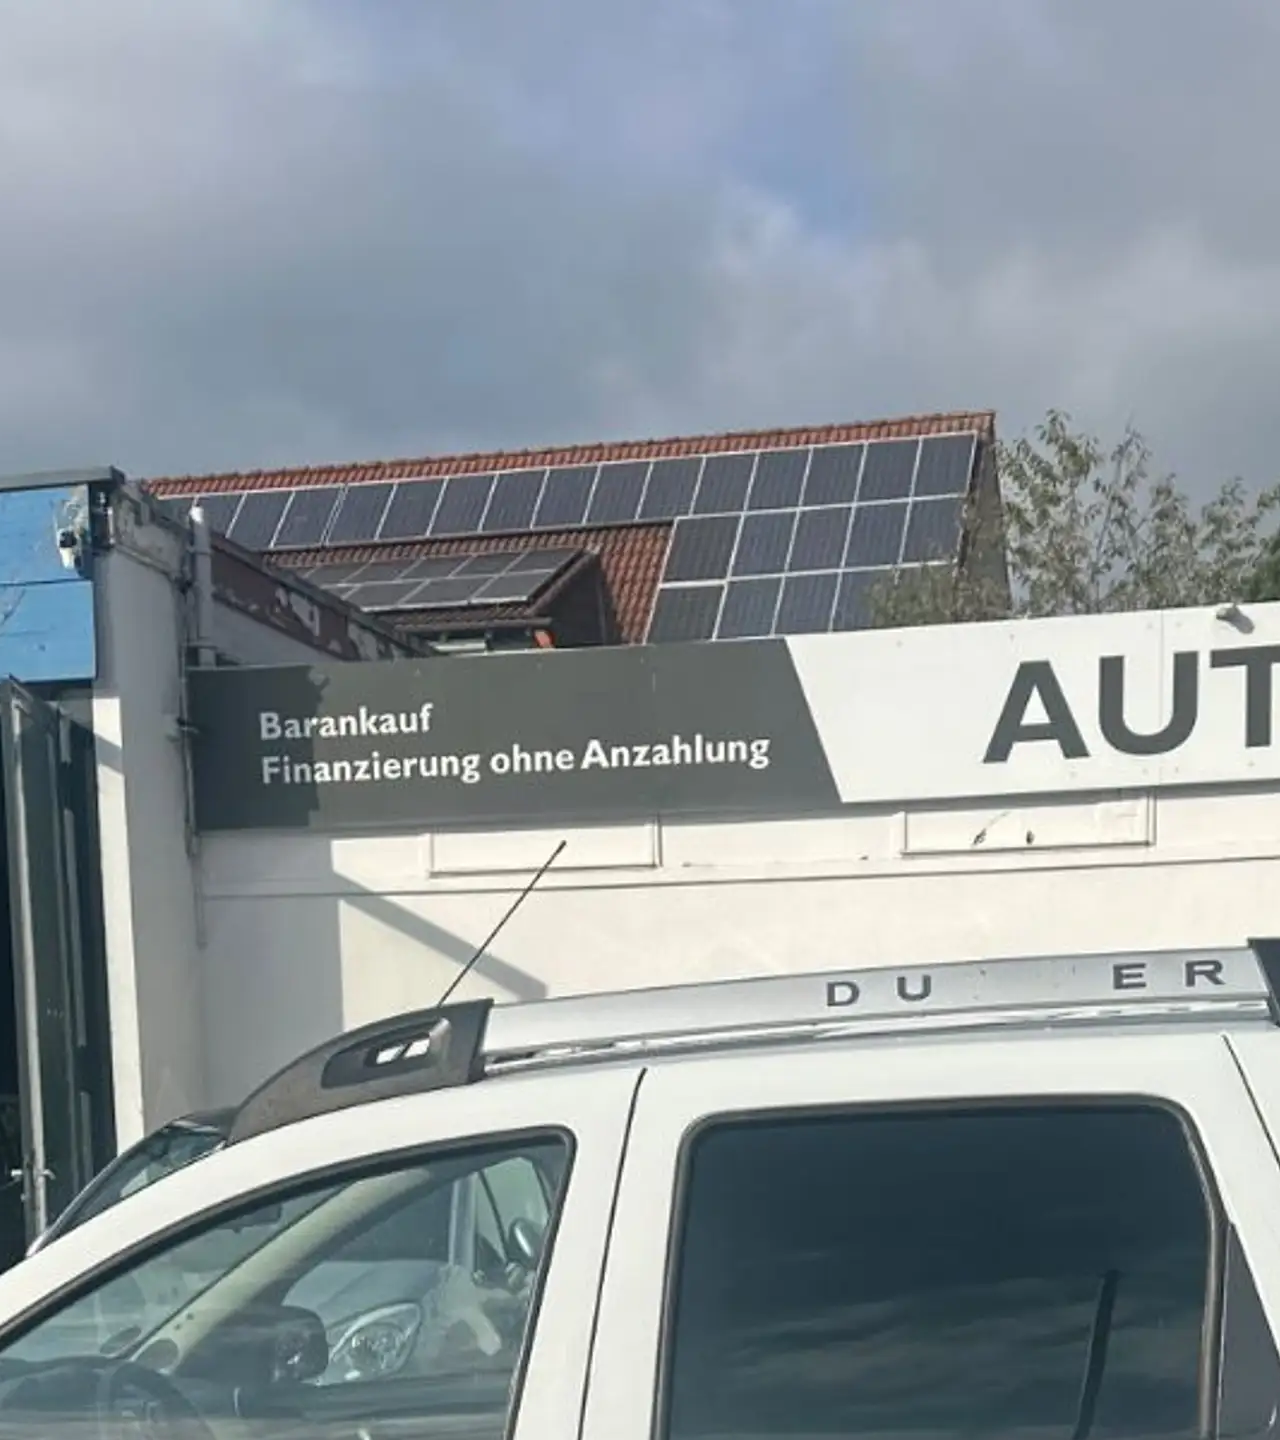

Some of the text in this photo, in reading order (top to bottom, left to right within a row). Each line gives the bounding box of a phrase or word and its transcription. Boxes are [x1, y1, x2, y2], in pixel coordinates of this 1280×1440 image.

[260, 702, 434, 740] Barankauf
[261, 733, 770, 784] Finanzierung ohne Anzahlung
